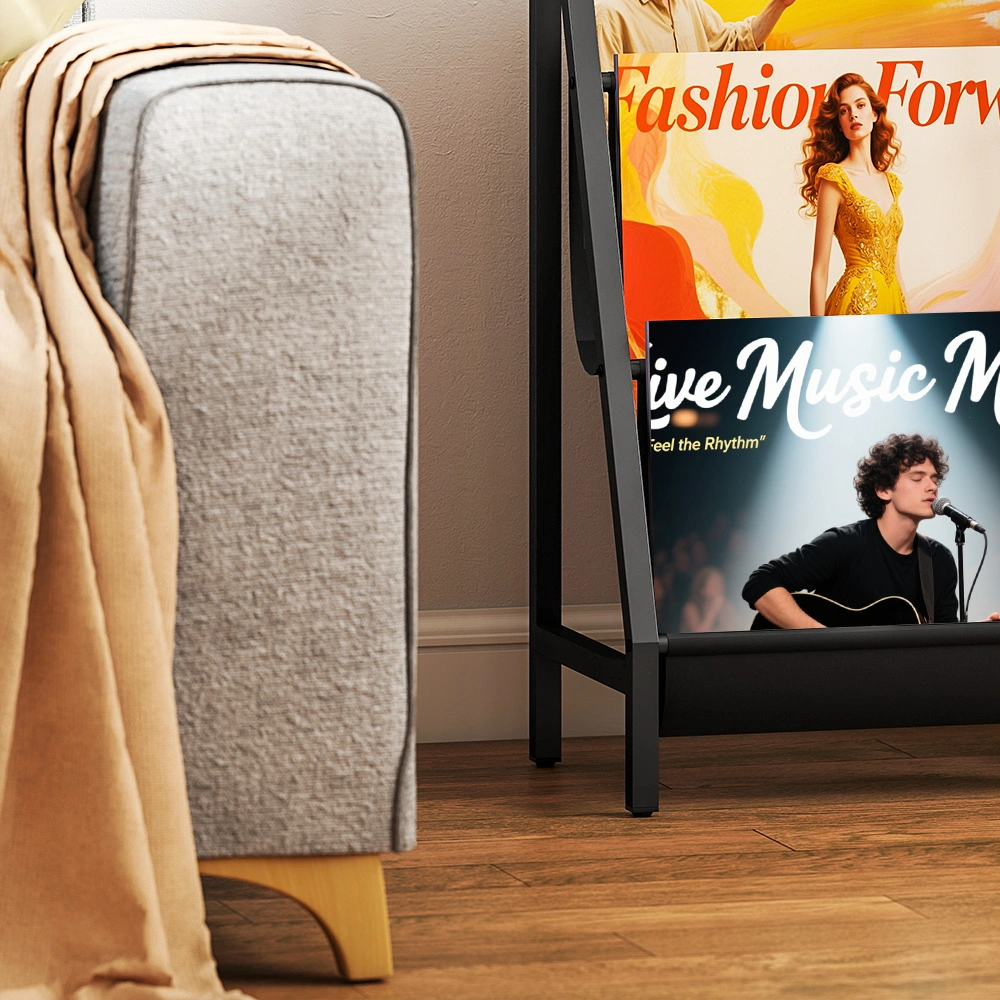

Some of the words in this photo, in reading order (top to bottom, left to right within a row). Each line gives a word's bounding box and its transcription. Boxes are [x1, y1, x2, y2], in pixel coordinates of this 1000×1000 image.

[649, 342, 732, 430] ive
[736, 337, 936, 440] Music
[678, 437, 701, 452] the
